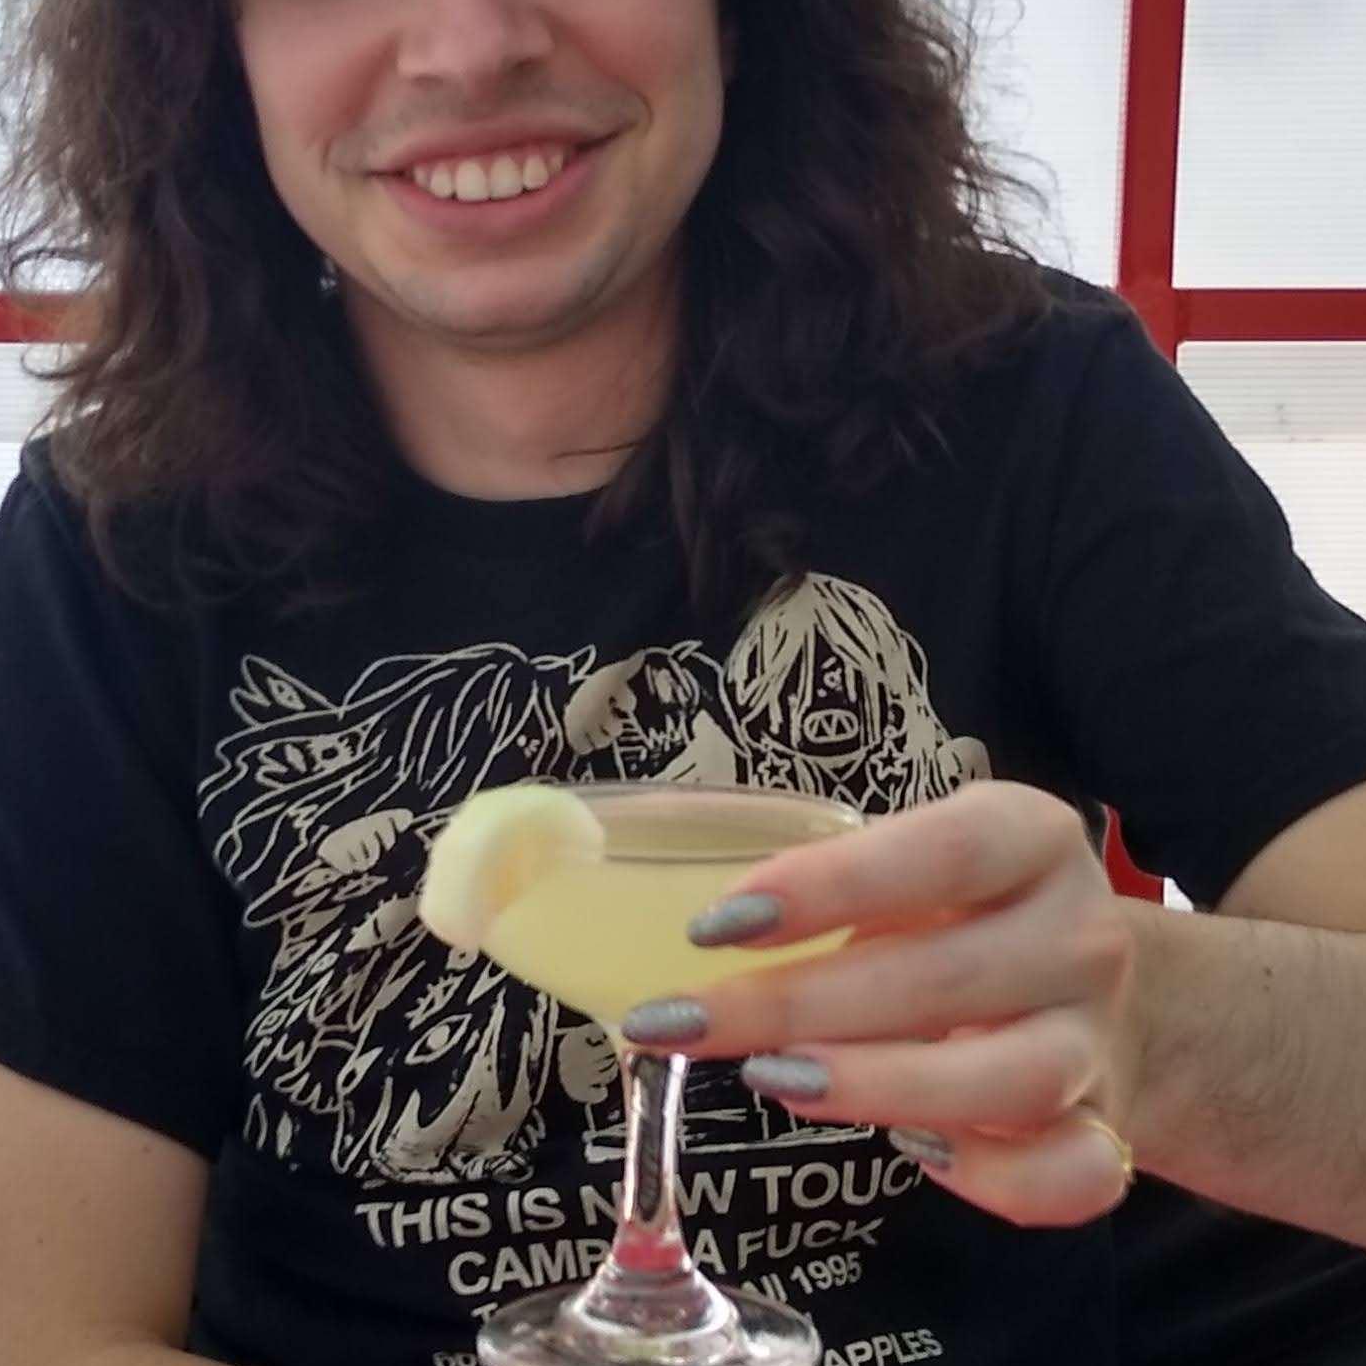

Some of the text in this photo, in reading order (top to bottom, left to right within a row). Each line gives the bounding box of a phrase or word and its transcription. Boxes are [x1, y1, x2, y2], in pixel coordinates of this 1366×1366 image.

[355, 1153, 925, 1248] THIS IS NW TOUC
[737, 1217, 884, 1271] FUCK
[790, 1251, 863, 1295] 1995
